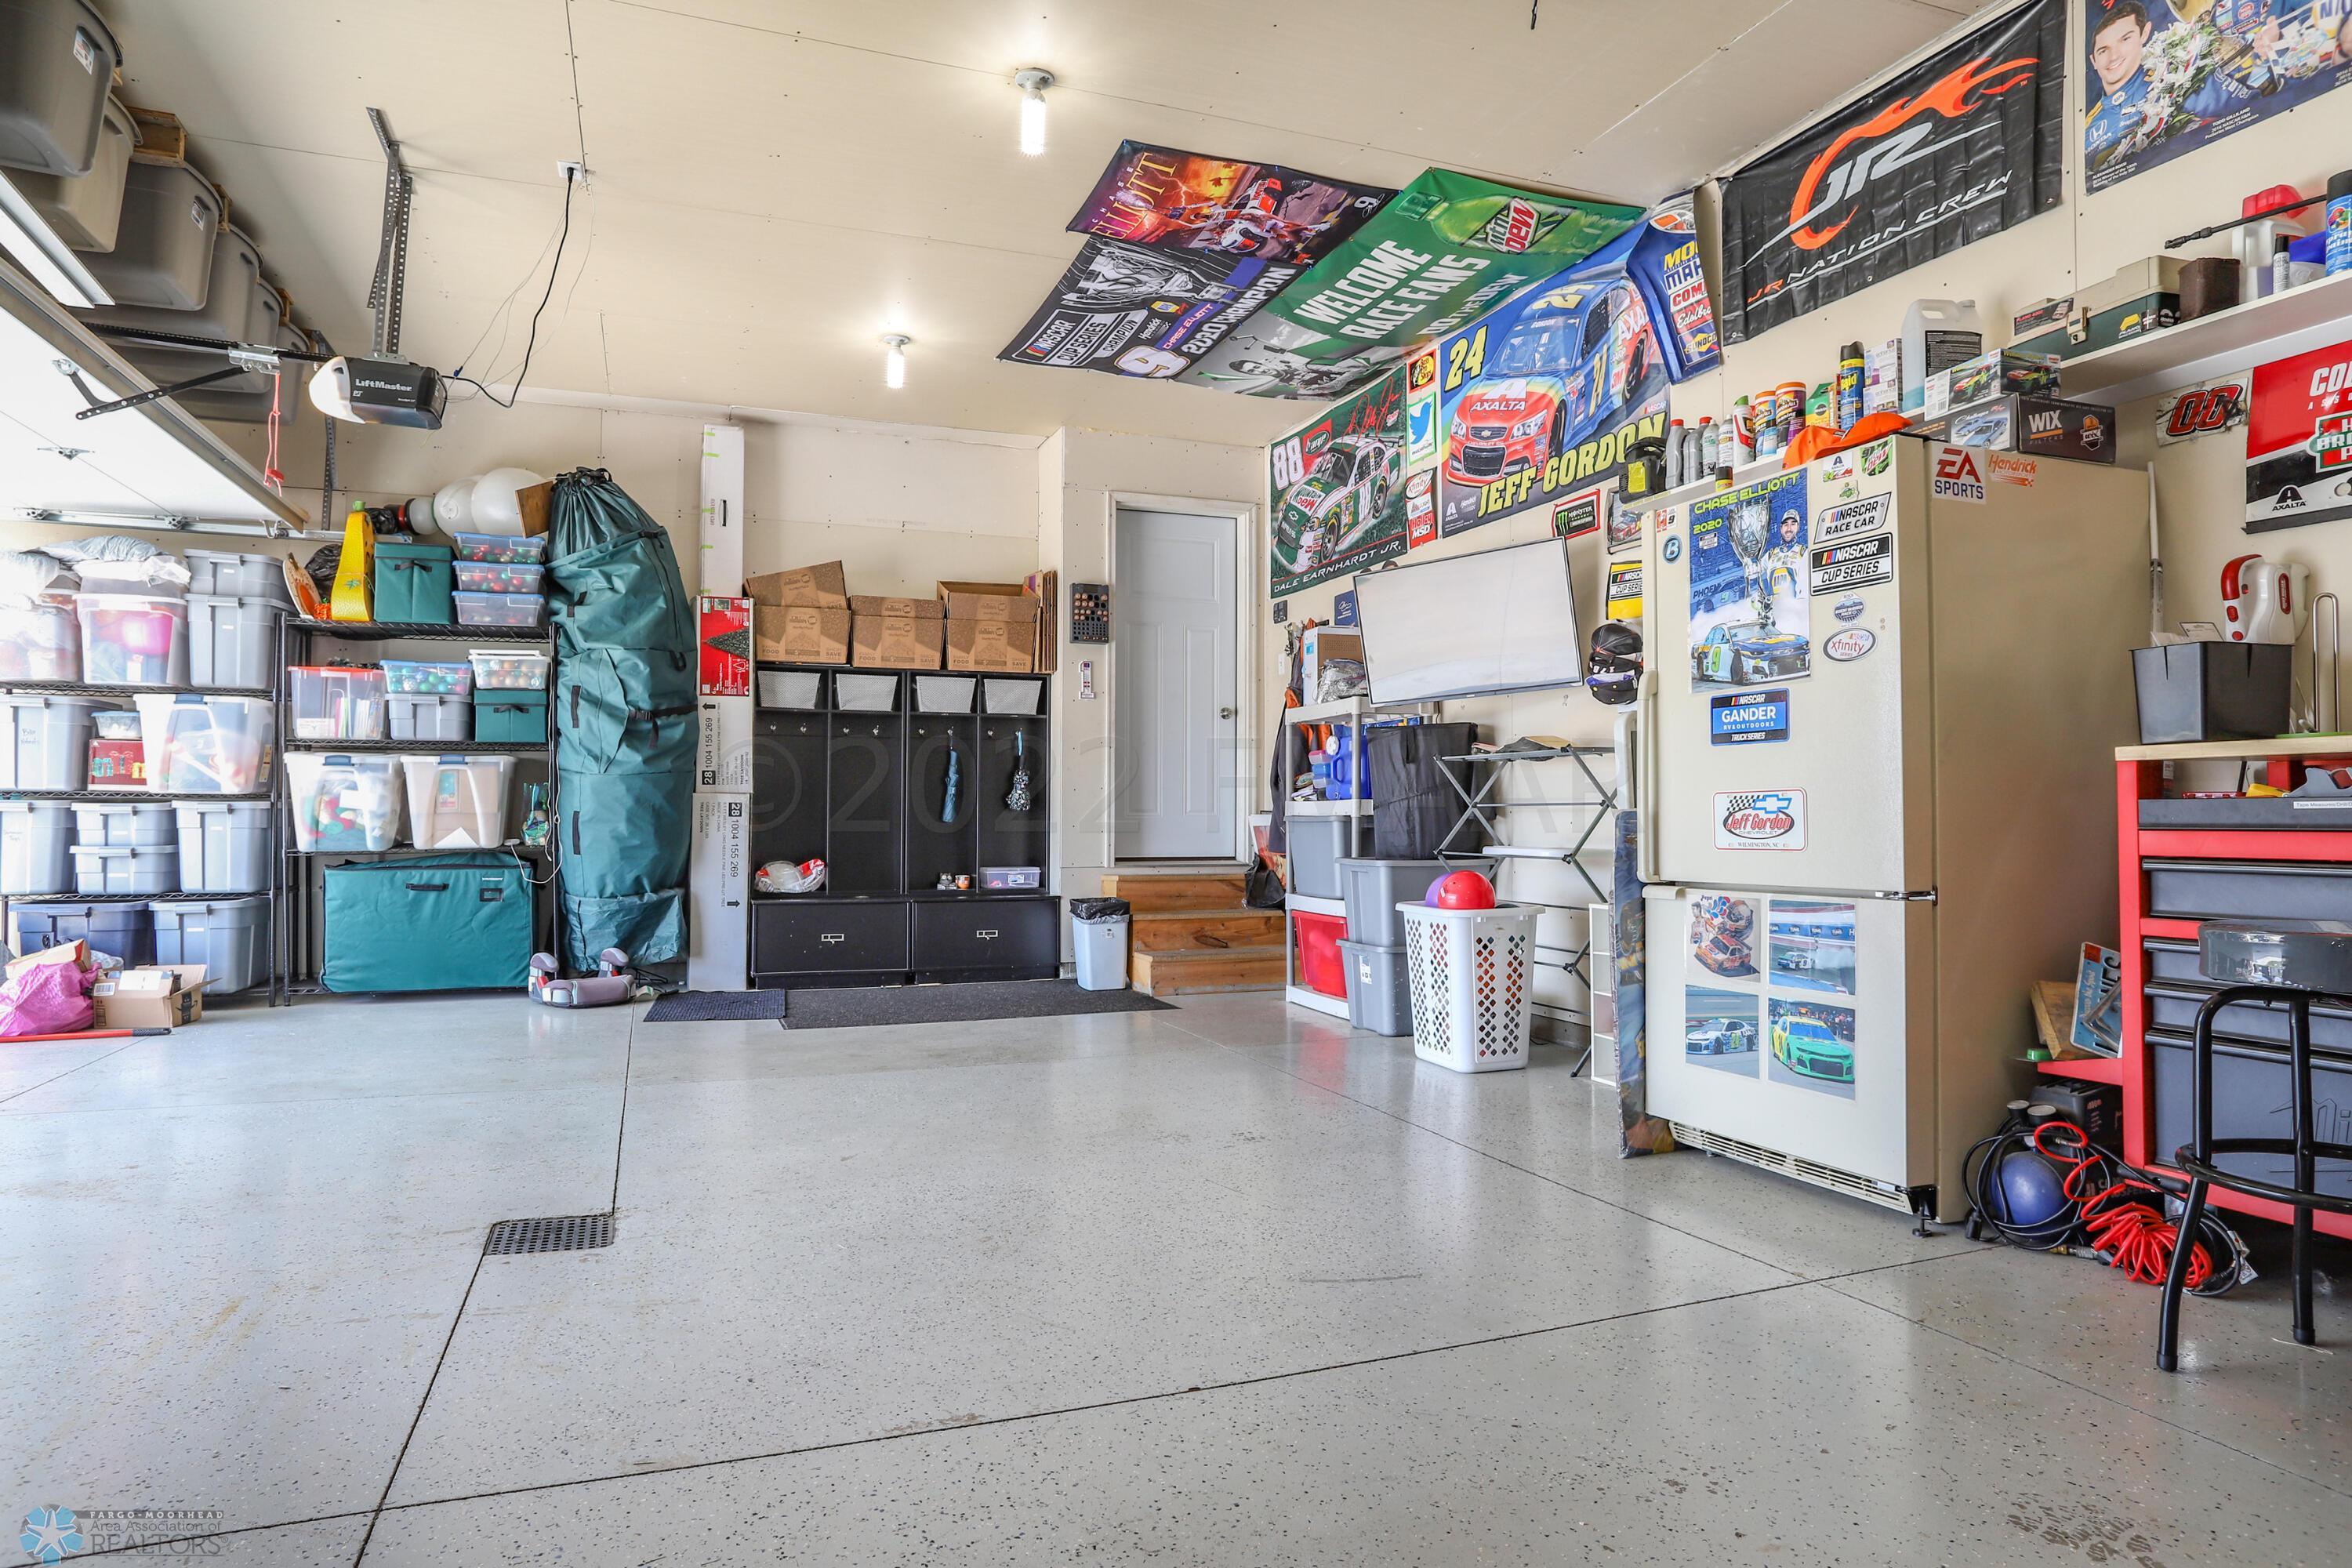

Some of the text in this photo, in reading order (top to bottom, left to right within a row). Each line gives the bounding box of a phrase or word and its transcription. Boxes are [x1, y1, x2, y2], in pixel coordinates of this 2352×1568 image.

[1091, 151, 1178, 240] ELLIOTT
[1748, 170, 2013, 304] JR NATION CREW
[1664, 240, 1698, 271] MO
[1293, 240, 1433, 325] WELCOME
[1672, 279, 1707, 307] COM
[1216, 267, 1297, 325] CHAMPION
[1339, 255, 1491, 340] RACE FANS
[1416, 317, 1456, 336] DO
[1677, 303, 1712, 329] Edelbro
[1036, 319, 1076, 350] NASCAR
[1058, 322, 1108, 361] CUP SERIES
[1102, 319, 1138, 352] CHAMPION
[1443, 325, 1488, 394] 24
[355, 378, 412, 392] LiftMaster
[1470, 401, 1526, 412] AXALTA
[2028, 409, 2063, 434] WIX
[1272, 435, 1305, 491] 88
[1936, 447, 1982, 483] EA
[1987, 453, 2038, 474] Hendrick
[1476, 464, 1539, 518] JEFF
[1694, 472, 1801, 514] CHASE ELLIOTT
[1934, 480, 1984, 499] SPORTS
[1838, 500, 1879, 522] NASCAR
[2272, 500, 2307, 512] AXALTA
[1668, 514, 1675, 524] 9
[1693, 518, 1723, 535] 2020
[1825, 514, 1875, 536] RACE CAR
[1412, 526, 1432, 540] MSD
[1835, 540, 1879, 563] NASCAR
[1274, 577, 1300, 593] DALE
[1302, 549, 1378, 583] EARNHARDT
[1821, 560, 1880, 584] CUP SERIES
[1628, 583, 1643, 592] SERIE
[1831, 638, 1865, 655] xfinity
[1739, 693, 1766, 706] NASCAR
[1721, 706, 1777, 723] GANDER
[1747, 731, 1766, 741] SERIES
[704, 771, 713, 784] 28
[1726, 812, 1793, 831] Jeff Gordon
[730, 803, 741, 877] 28 1004 155 269
